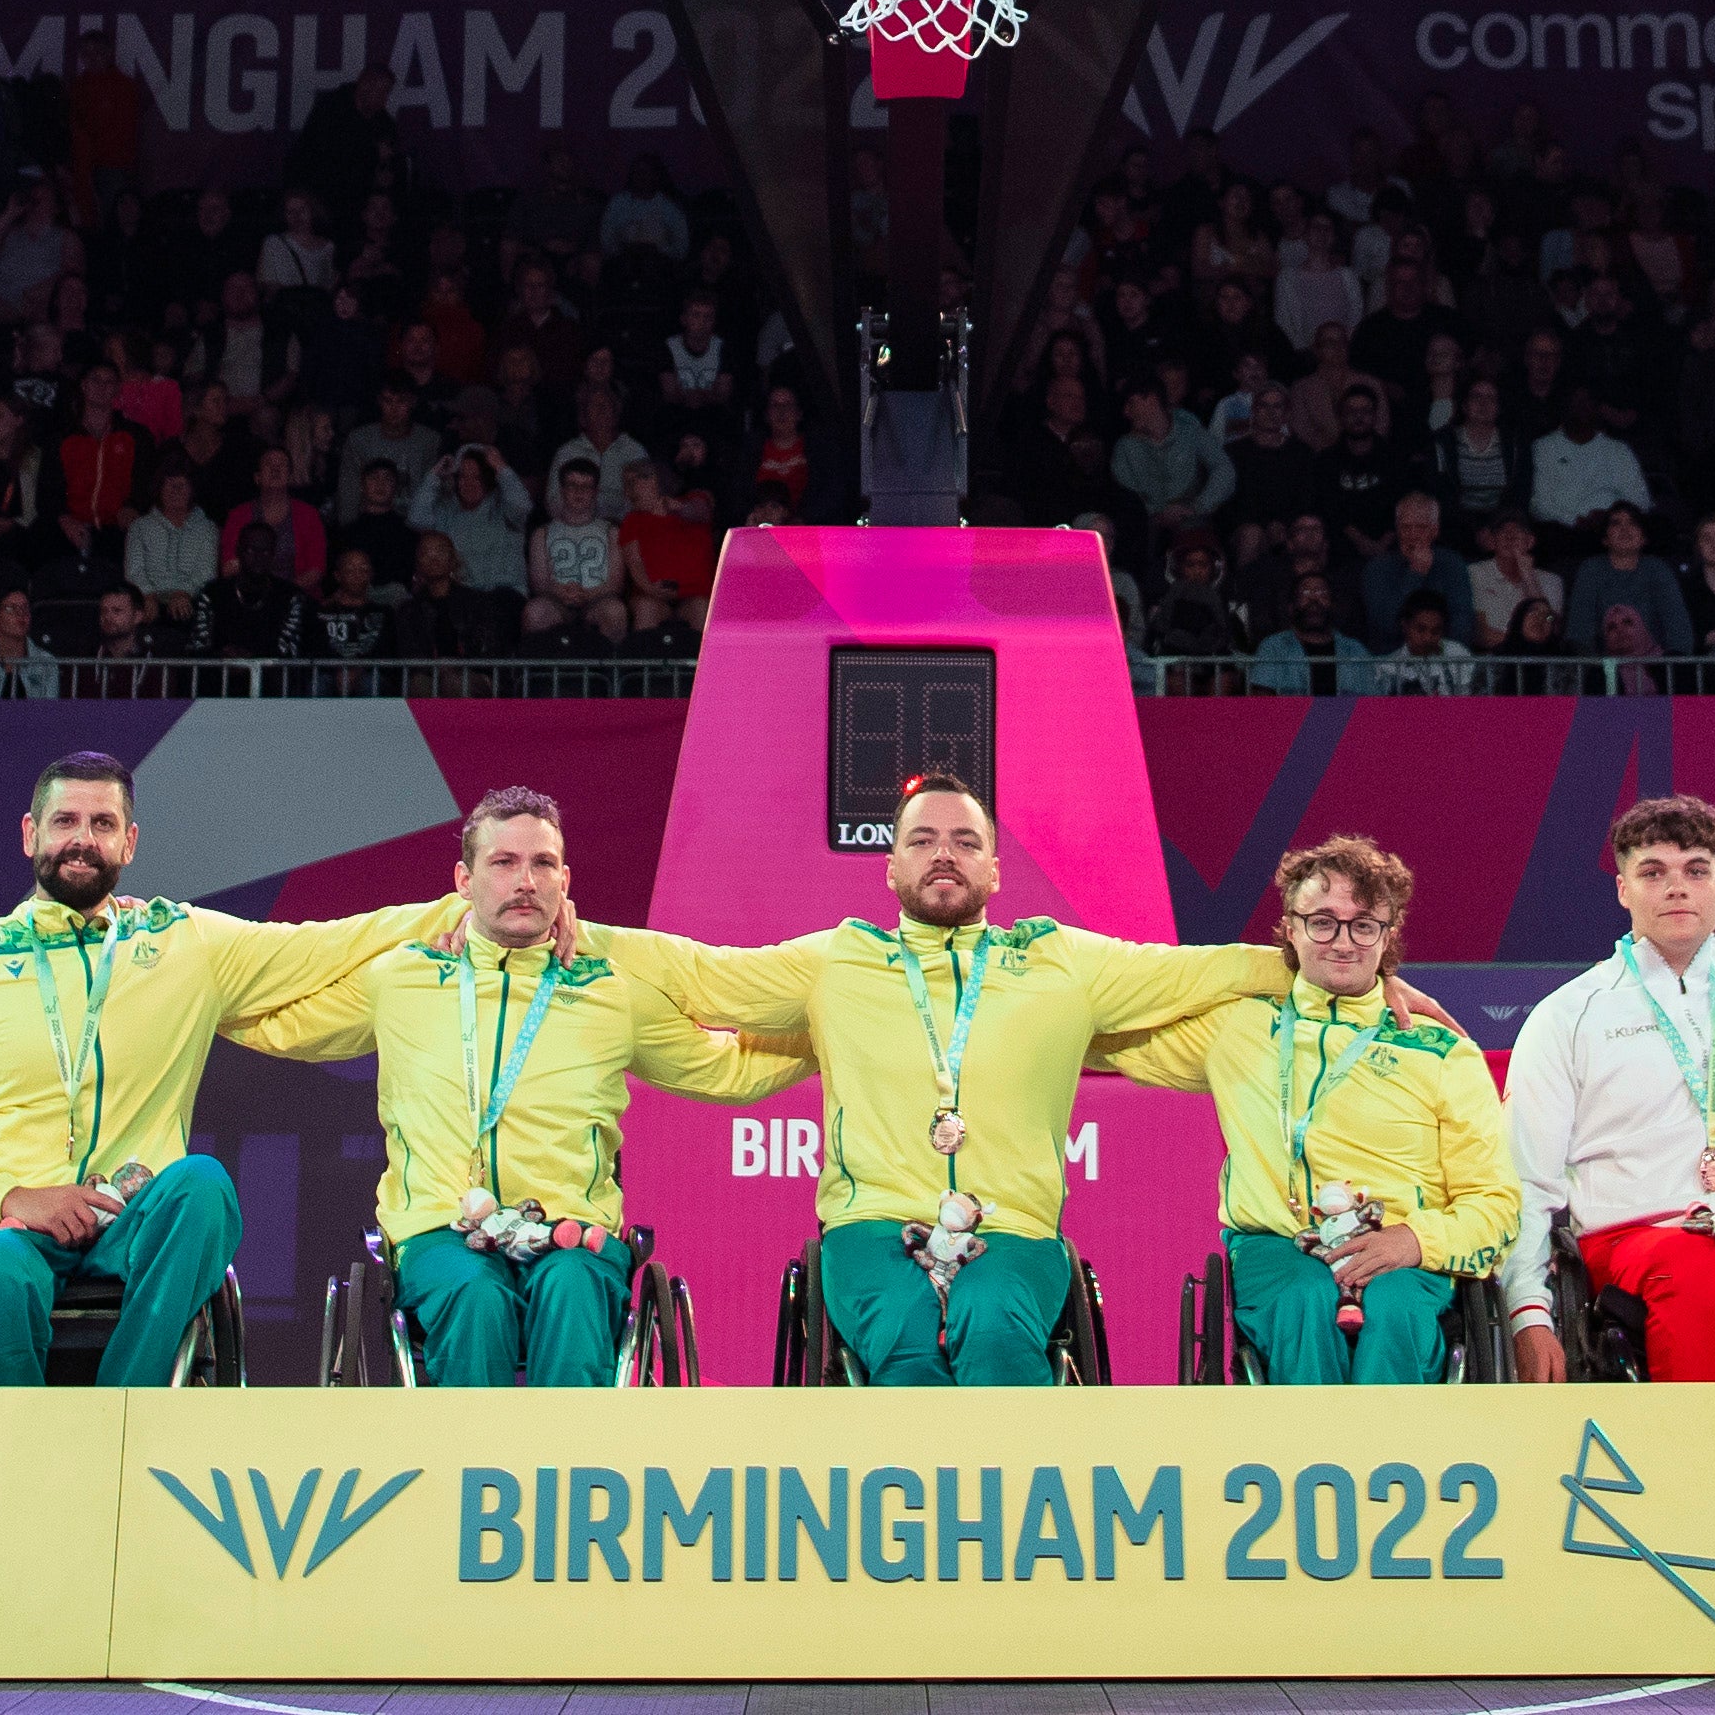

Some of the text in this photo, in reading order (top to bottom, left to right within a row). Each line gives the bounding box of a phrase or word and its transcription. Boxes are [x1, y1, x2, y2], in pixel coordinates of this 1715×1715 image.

[838, 823, 895, 845] LON
[458, 1462, 1504, 1583] BIRMINGHAM 2022
